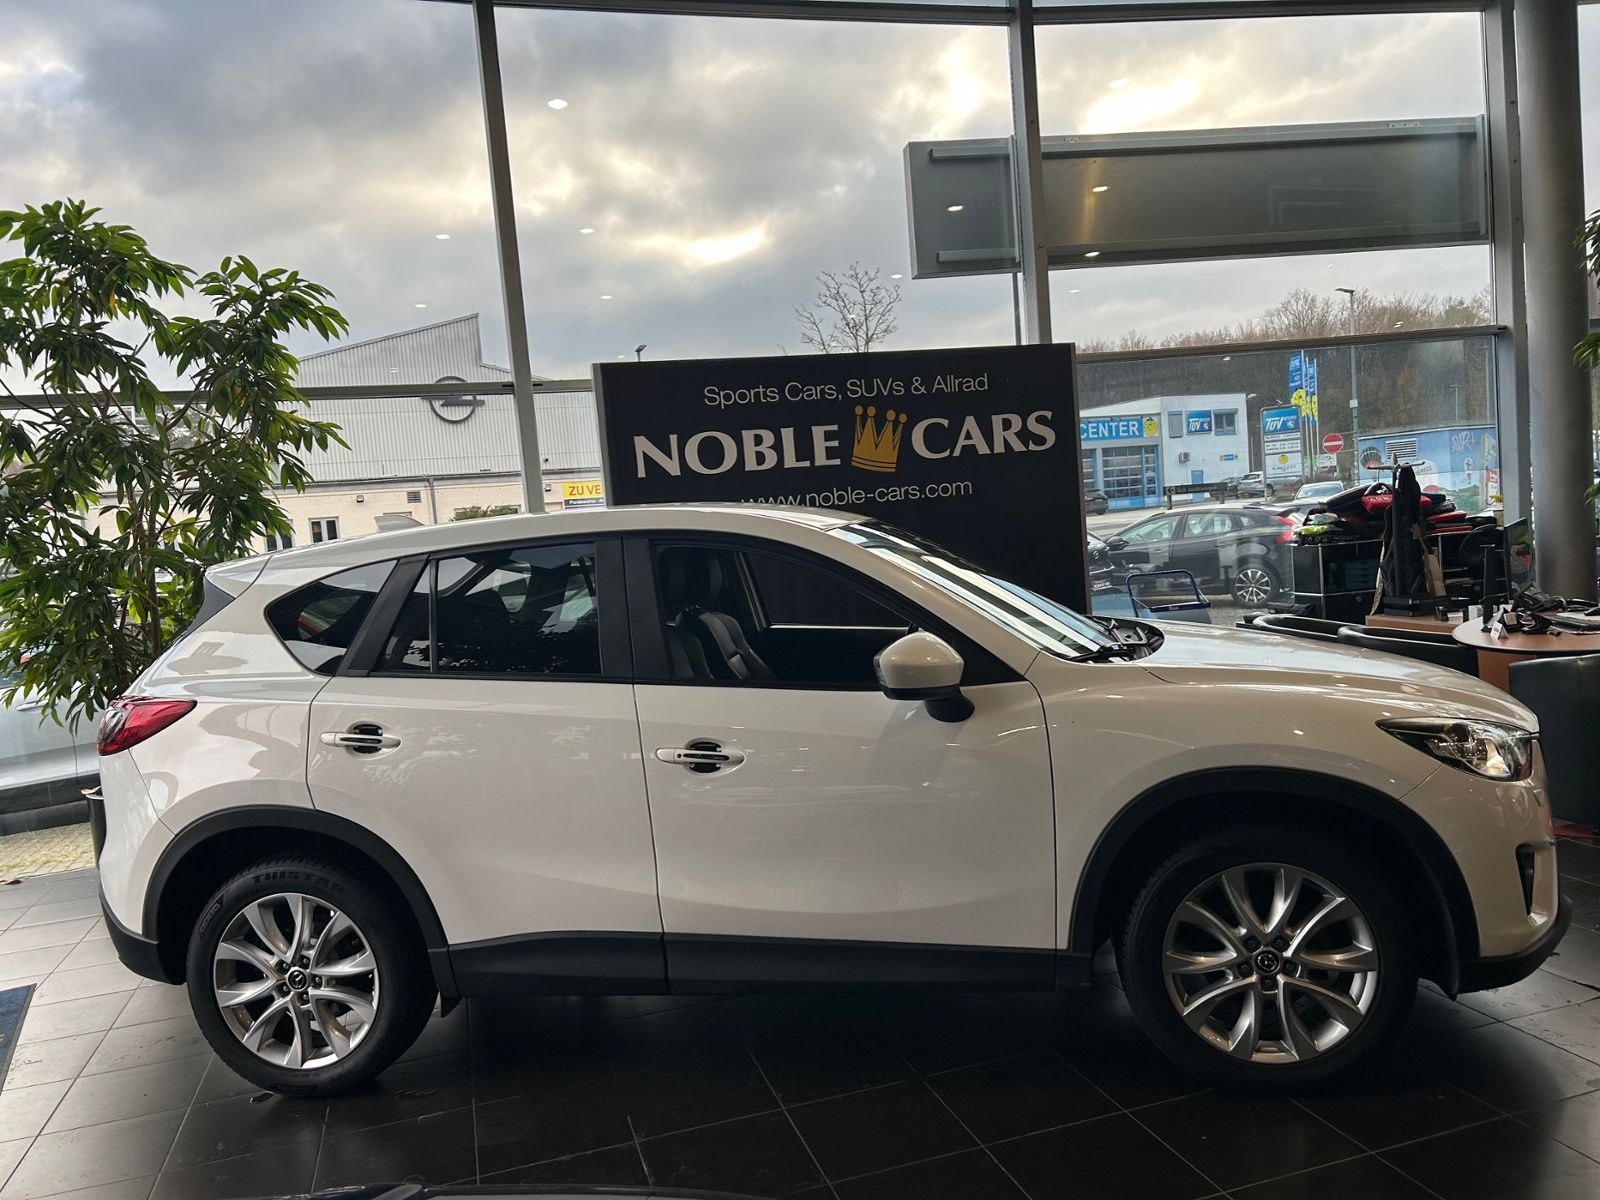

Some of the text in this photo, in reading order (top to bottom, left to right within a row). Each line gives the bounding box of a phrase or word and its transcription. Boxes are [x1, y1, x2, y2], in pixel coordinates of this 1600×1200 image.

[704, 372, 989, 410] Sports Cars, SUVs & Allrad
[1080, 421, 1140, 438] CENTER
[633, 410, 1056, 479] NOBLE CARS
[568, 485, 585, 496] ZU
